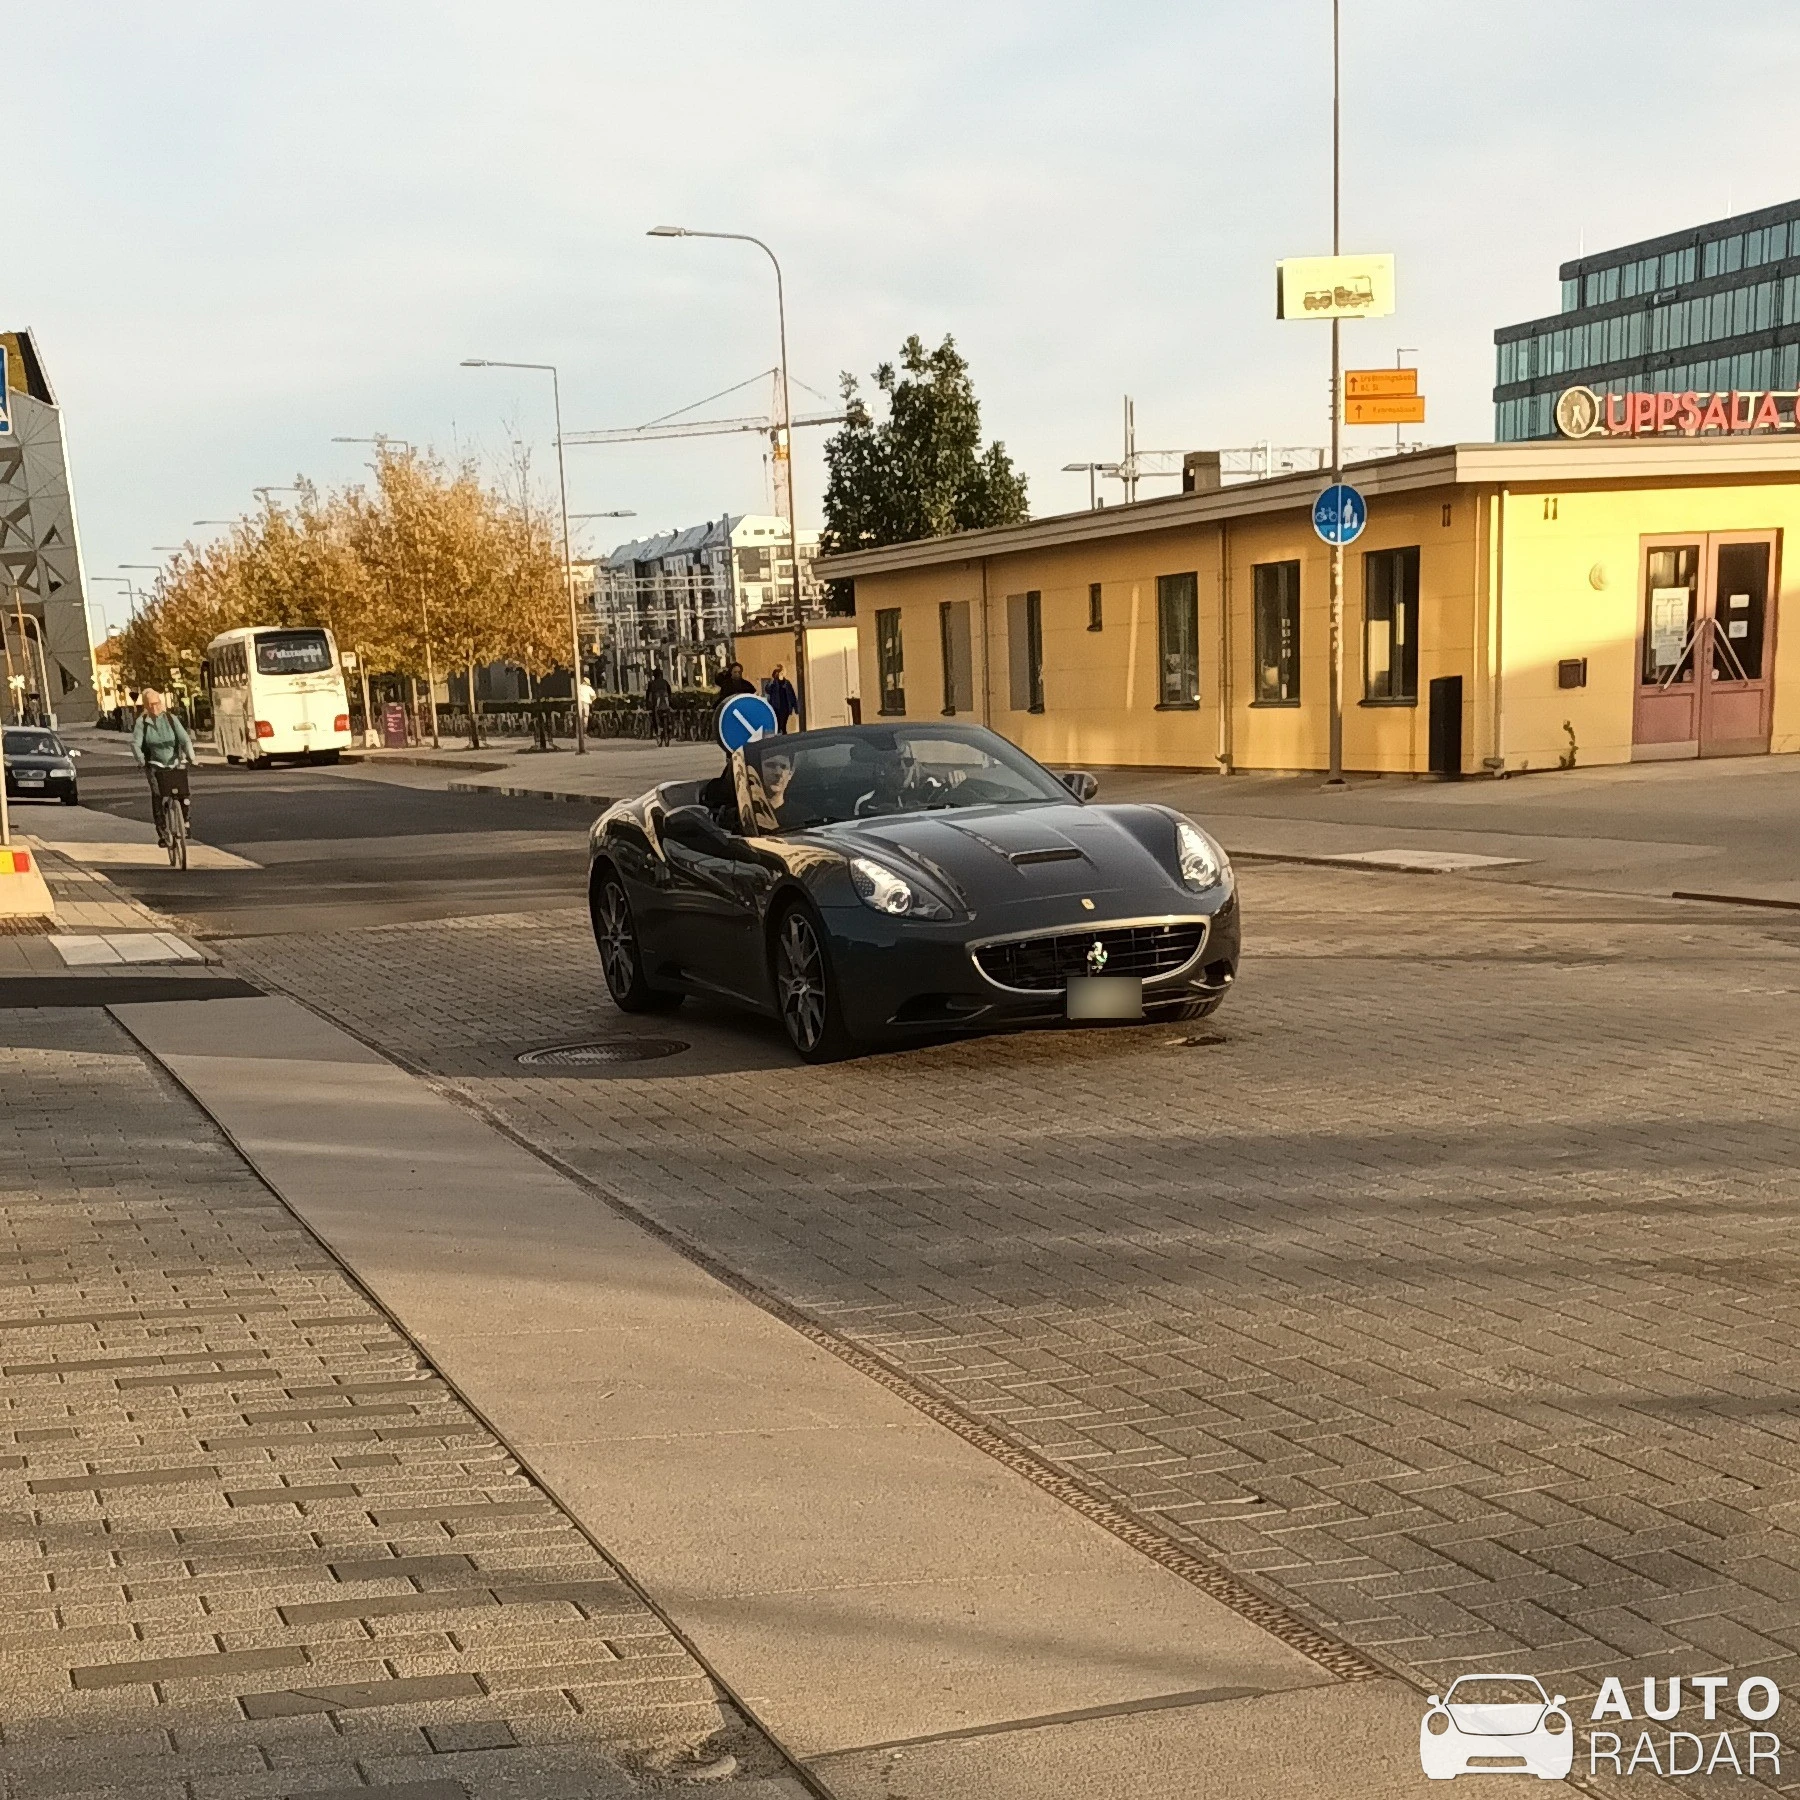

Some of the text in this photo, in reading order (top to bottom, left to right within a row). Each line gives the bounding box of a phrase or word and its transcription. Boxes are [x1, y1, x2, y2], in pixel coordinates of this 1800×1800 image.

[1606, 390, 1780, 433] UPPSALA
[1442, 504, 1451, 527] 11
[1544, 498, 1558, 520] 11
